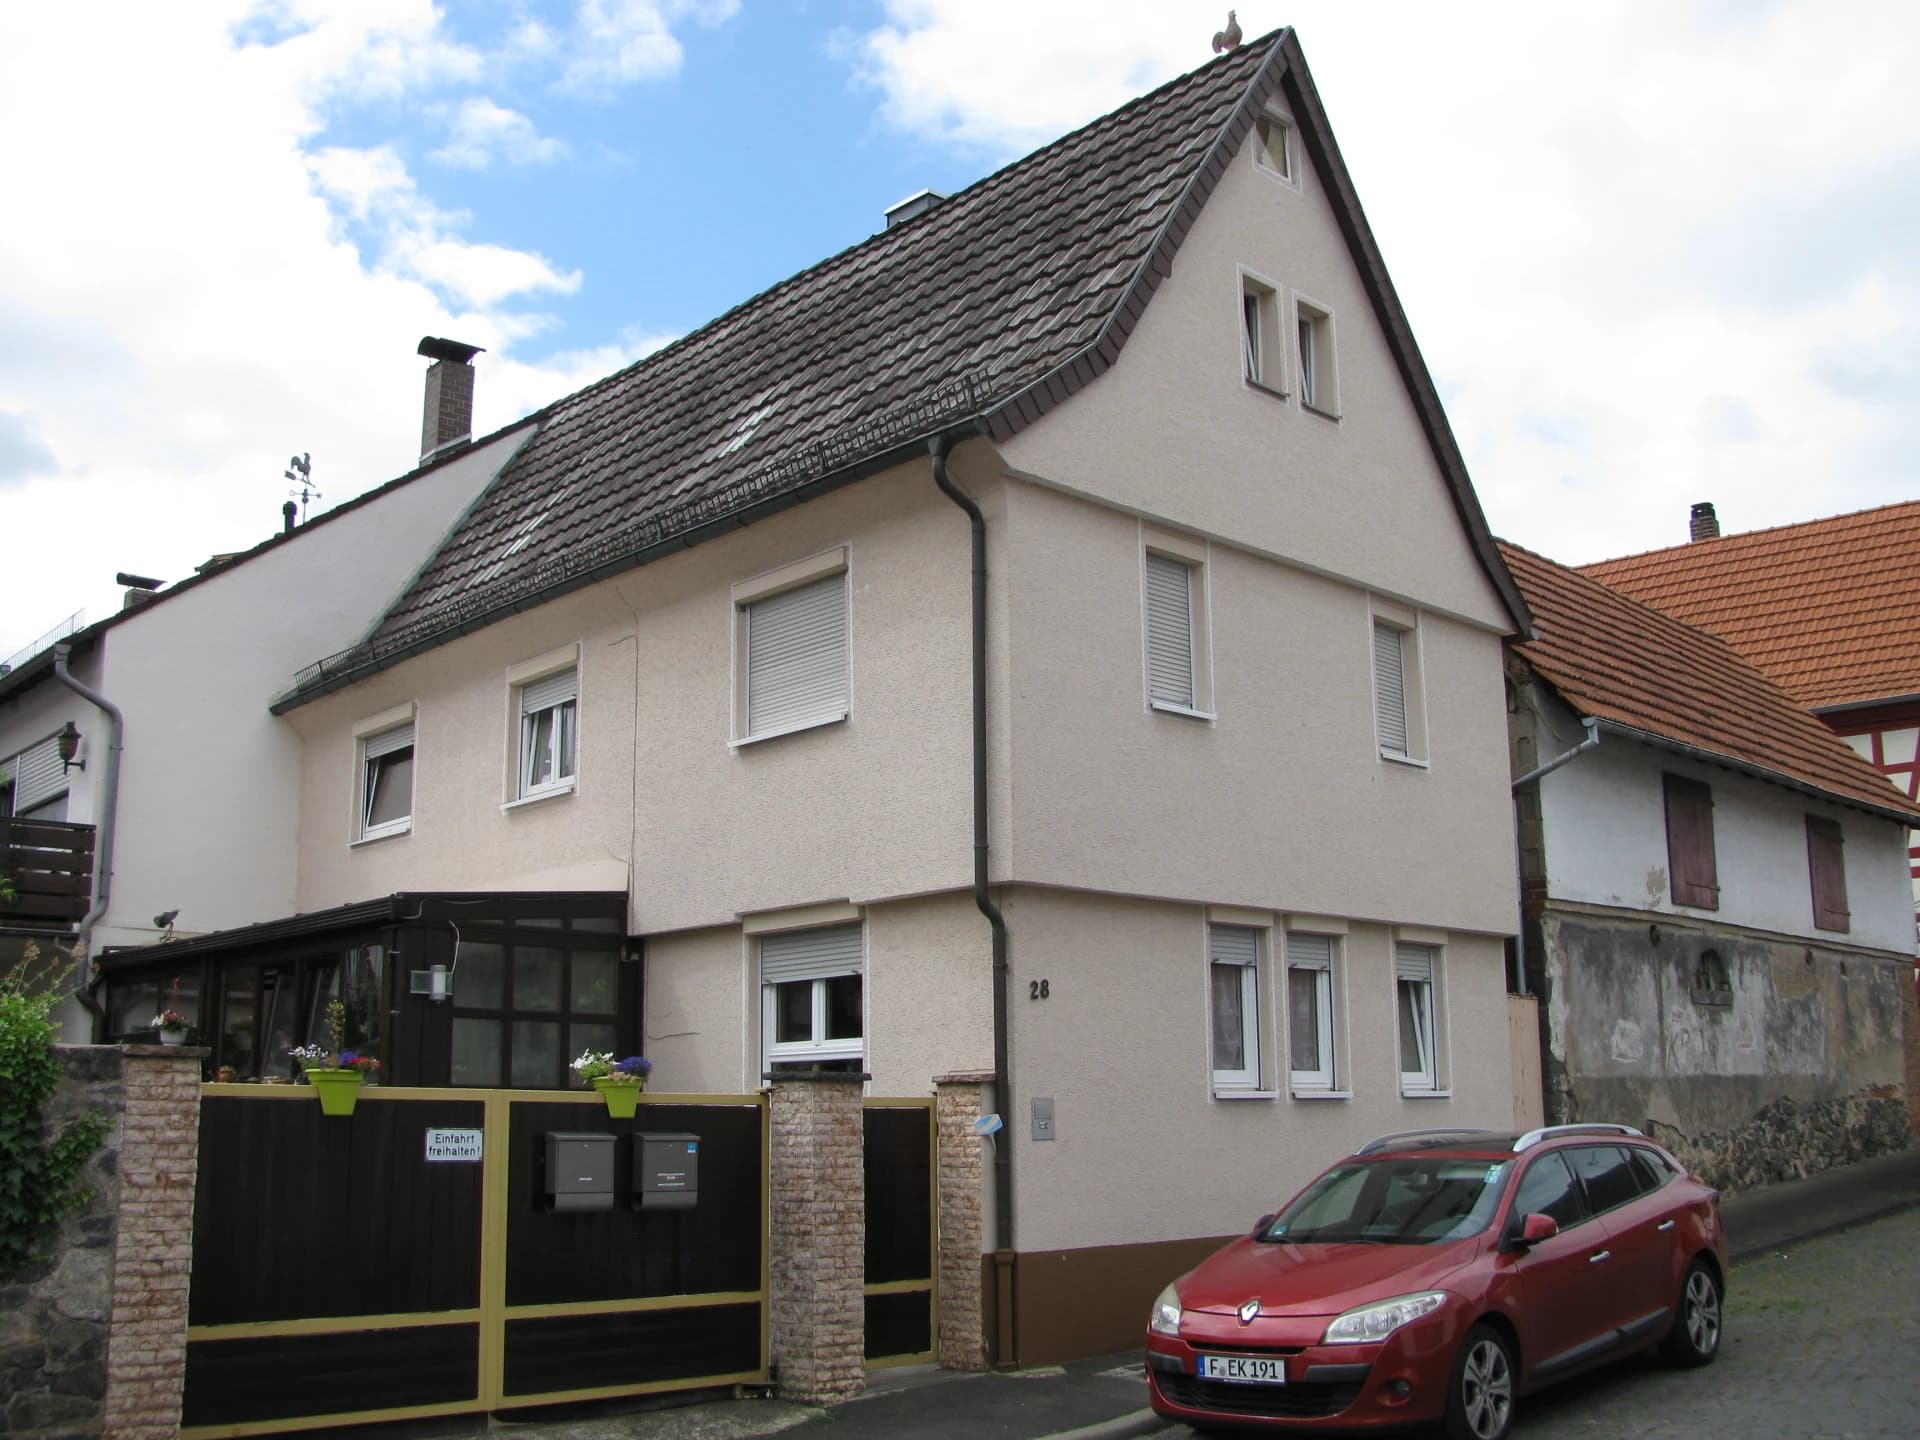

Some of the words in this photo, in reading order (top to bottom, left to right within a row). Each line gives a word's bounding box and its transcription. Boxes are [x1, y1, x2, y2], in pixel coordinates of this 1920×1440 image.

[1030, 979, 1050, 1000] 28
[435, 1133, 474, 1144] Einfahrt
[429, 1145, 480, 1156] freihalten!
[1209, 1358, 1218, 1376] F
